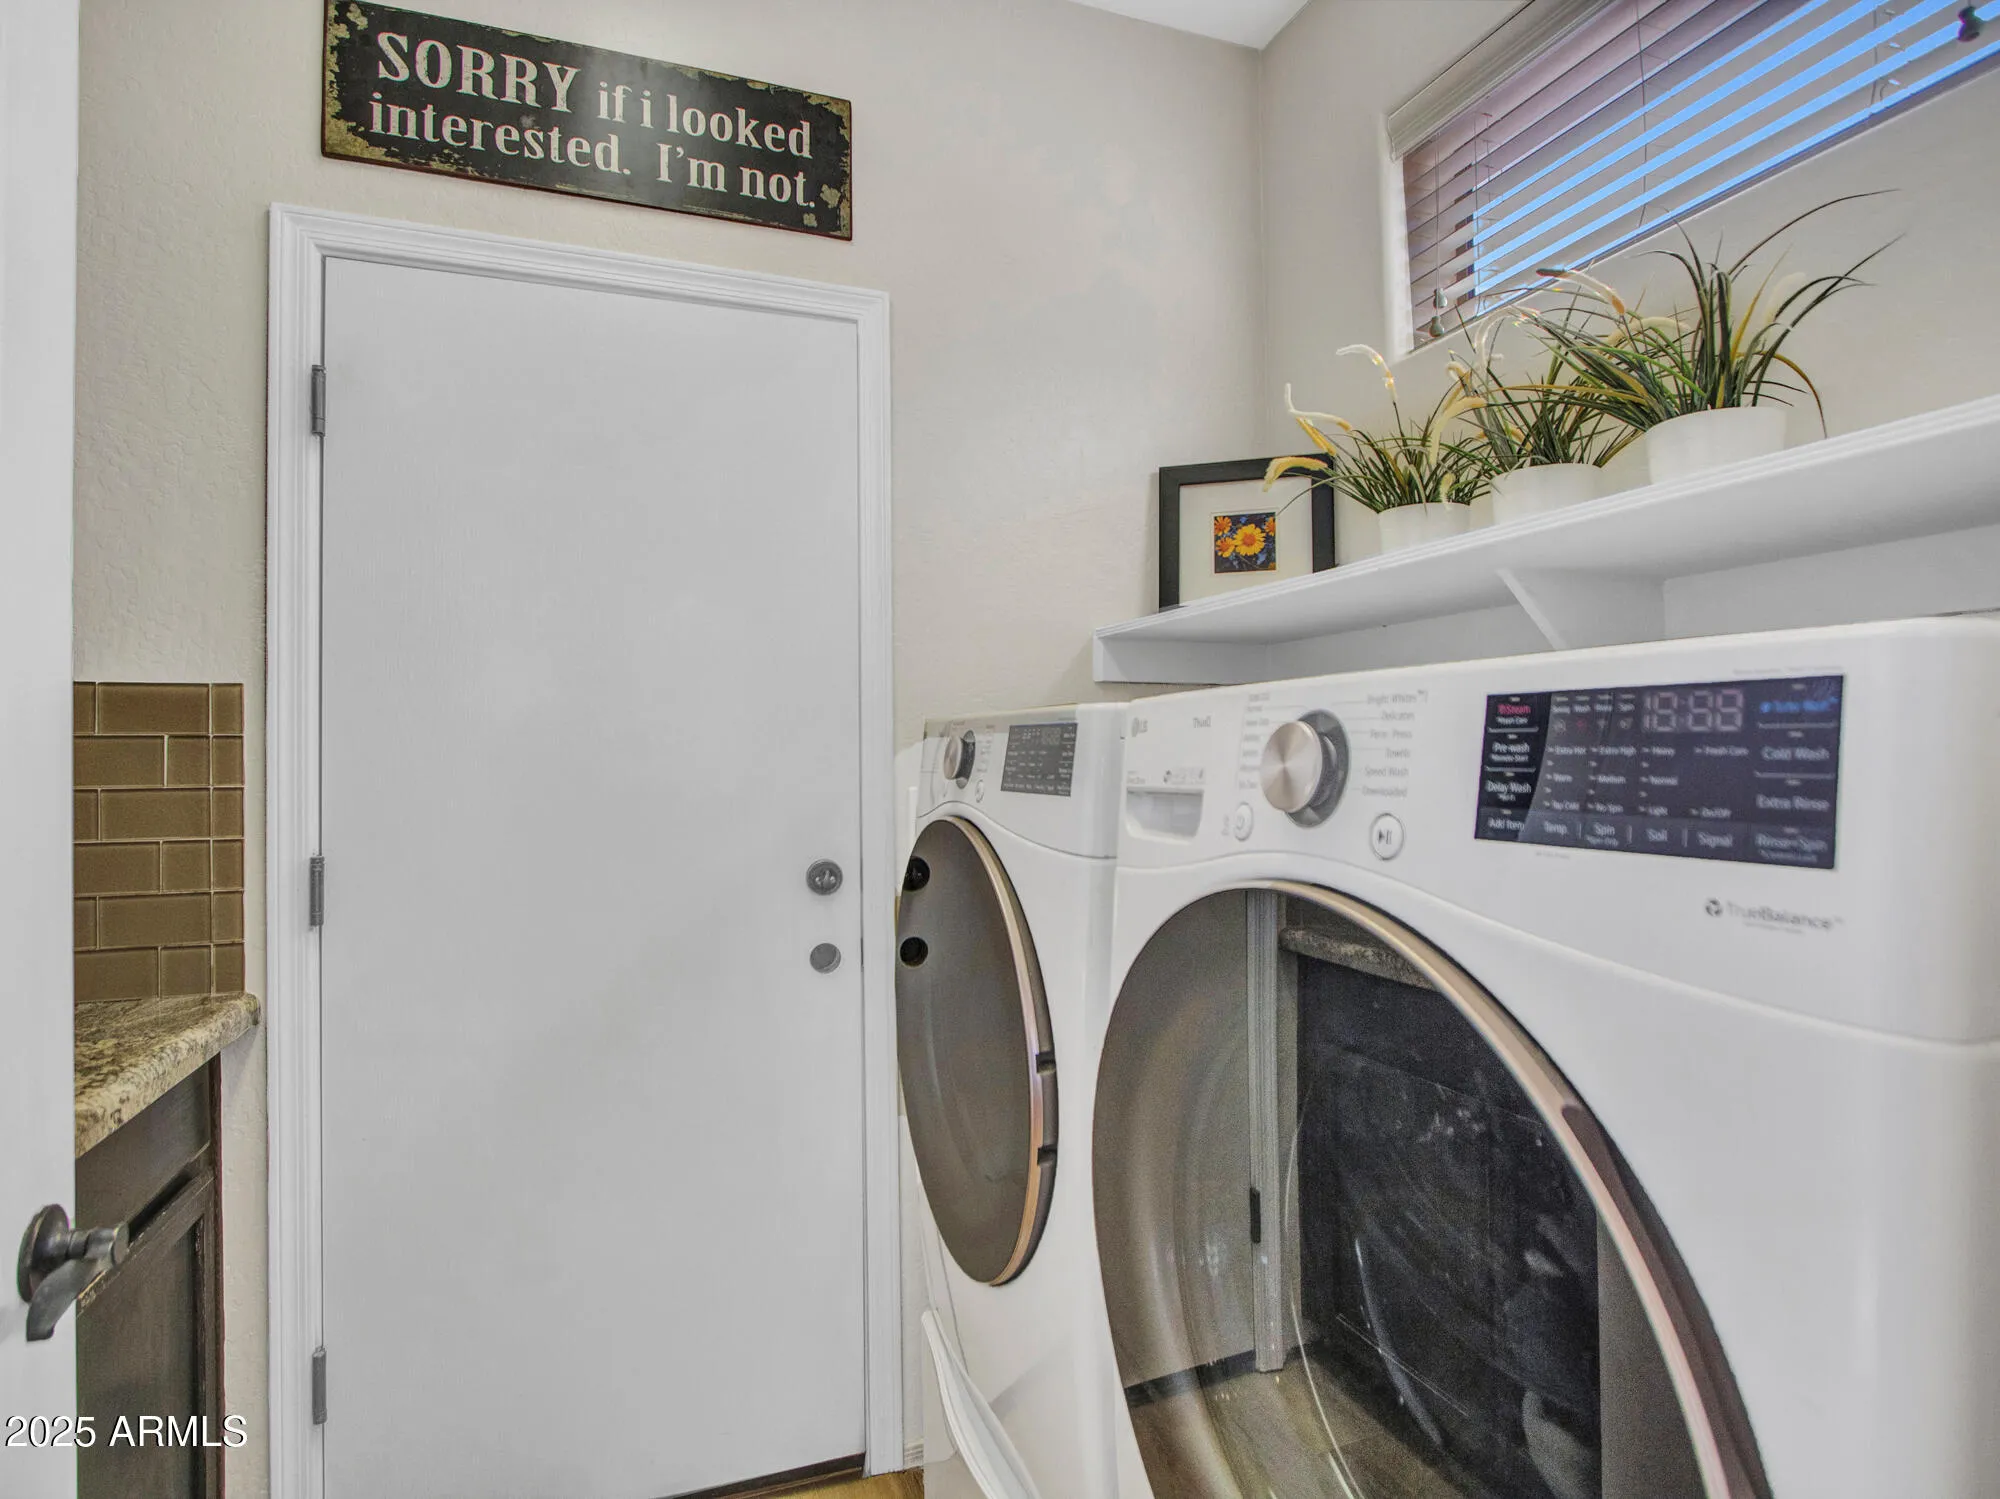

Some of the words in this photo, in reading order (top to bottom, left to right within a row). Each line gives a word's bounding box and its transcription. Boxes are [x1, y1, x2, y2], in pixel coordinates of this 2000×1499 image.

[368, 92, 631, 175] interested.
[656, 142, 727, 193] I'm
[739, 167, 816, 208] not.
[376, 31, 581, 113] SORRY
[597, 81, 633, 123] if
[639, 90, 654, 128] i
[666, 94, 813, 158] looked
